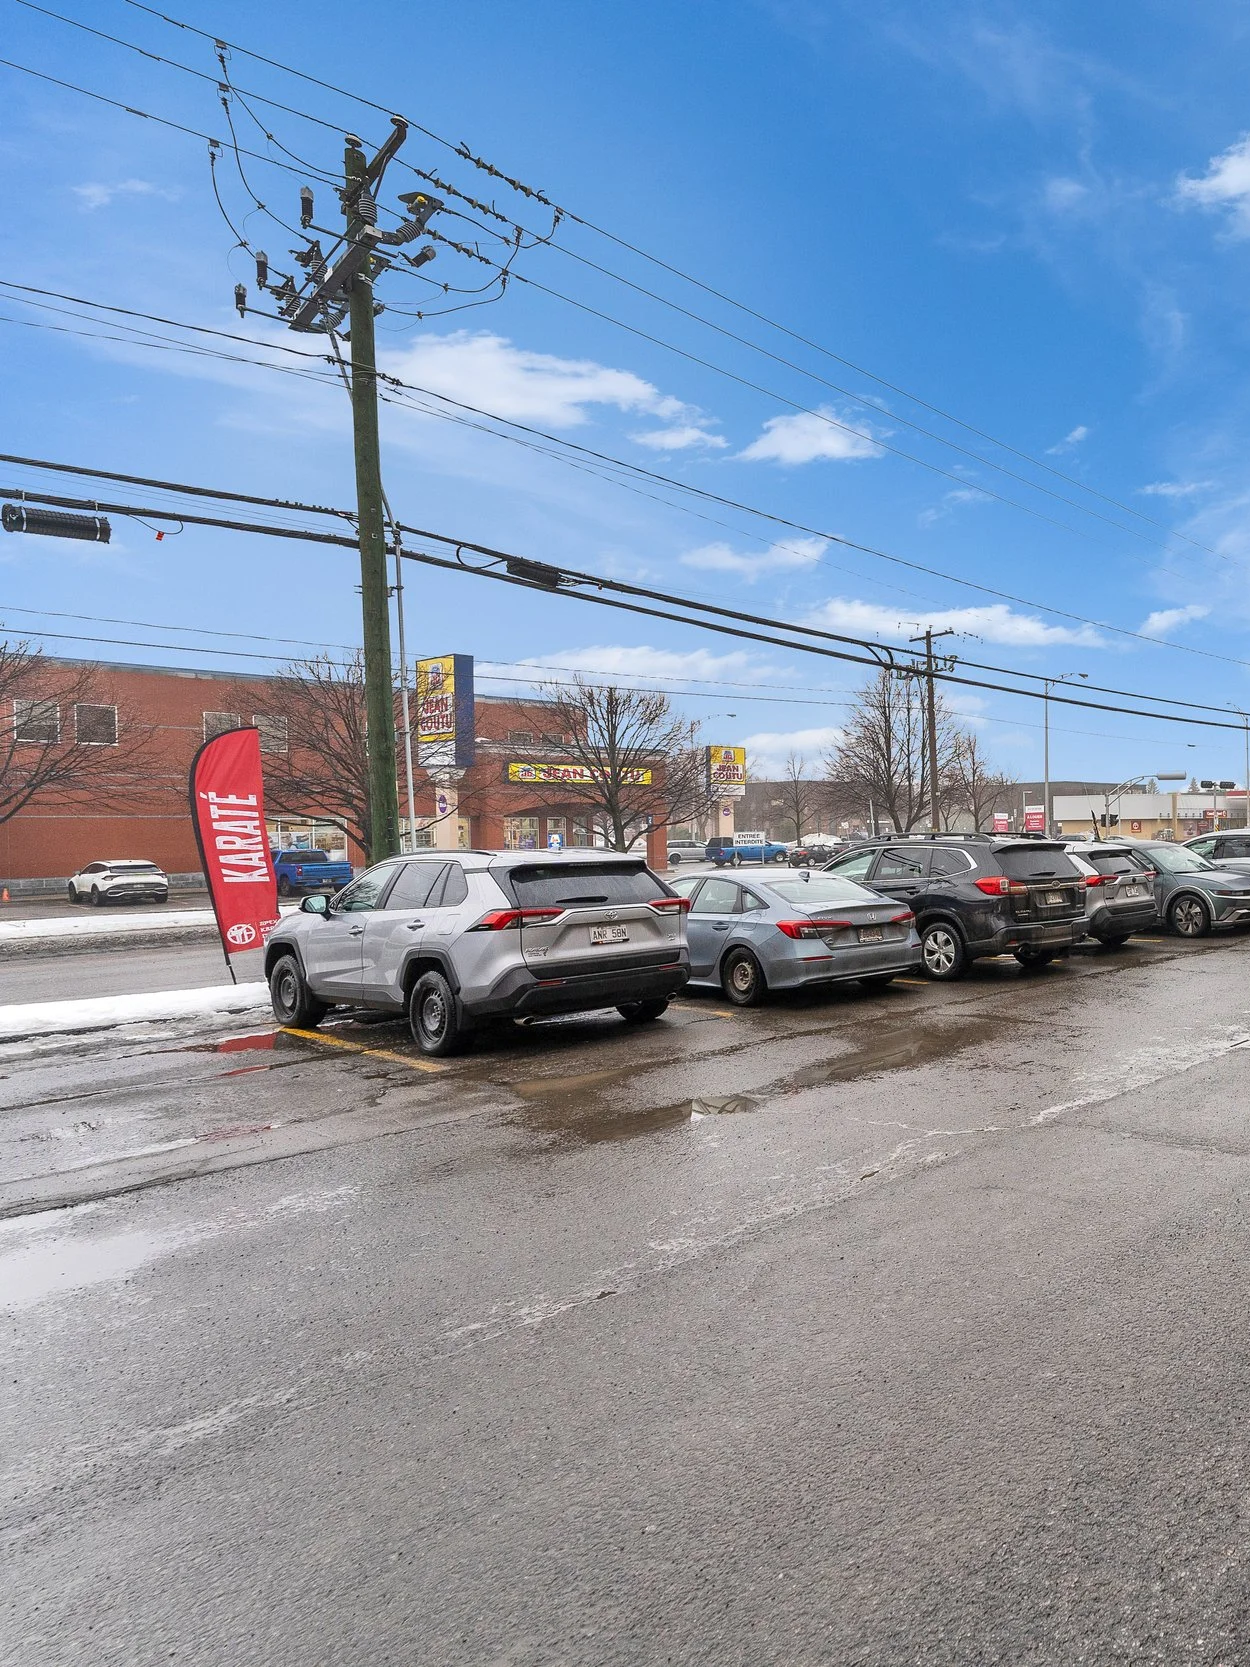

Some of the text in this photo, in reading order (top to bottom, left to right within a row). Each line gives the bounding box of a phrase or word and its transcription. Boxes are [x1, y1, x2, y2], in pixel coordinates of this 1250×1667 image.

[423, 695, 449, 715] JEAN
[420, 713, 454, 732] COUTU
[542, 767, 584, 779] JEAN
[716, 764, 739, 772] JEAN
[713, 771, 743, 780] COUTU
[199, 791, 270, 883] KARATÉ
[593, 929, 608, 940] ANR
